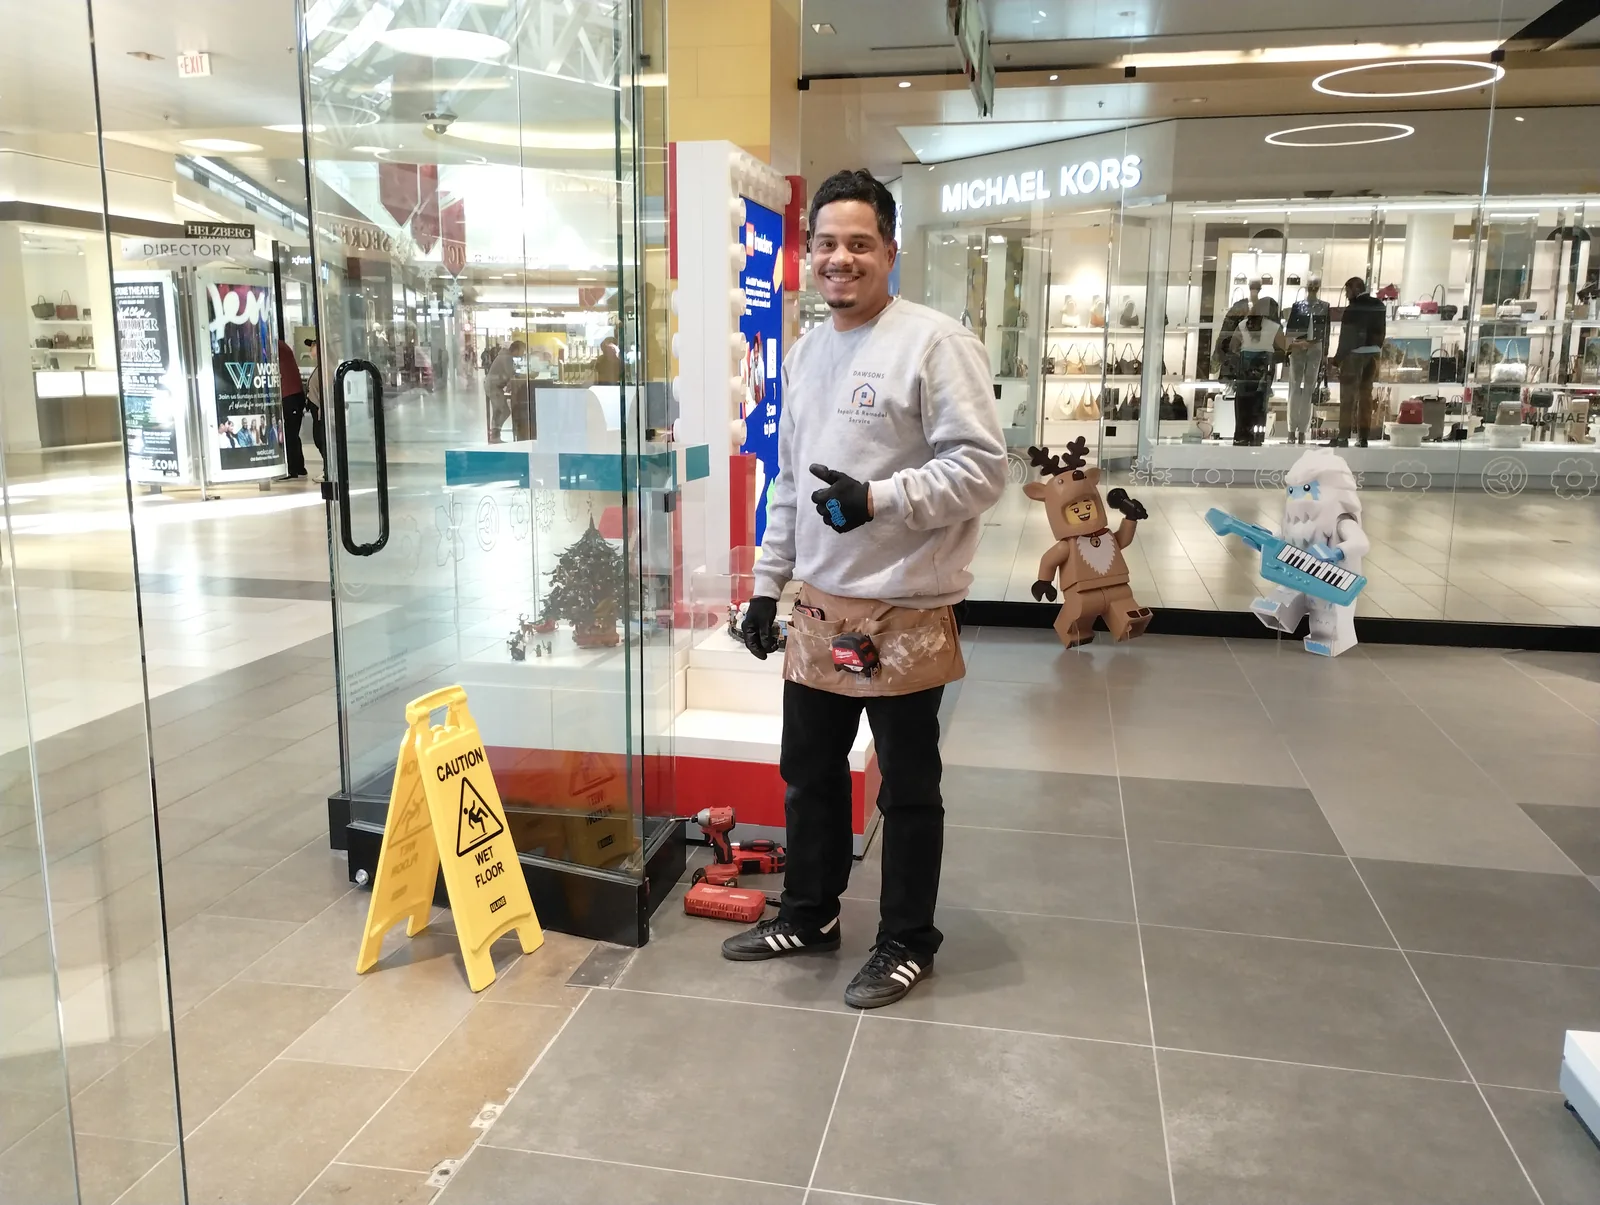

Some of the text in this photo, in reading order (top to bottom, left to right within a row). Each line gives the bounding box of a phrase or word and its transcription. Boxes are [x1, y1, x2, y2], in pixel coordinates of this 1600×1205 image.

[184, 55, 204, 74] EXIT
[942, 154, 1142, 213] MICHAEL KORS
[187, 225, 251, 239] HELZBERG
[143, 243, 231, 256] DIRECTORY
[129, 286, 160, 295] THEATRE
[853, 370, 885, 379] DAWSONS
[254, 375, 267, 389] OF
[849, 416, 871, 424] Service
[862, 410, 888, 418] Remodel
[1525, 412, 1596, 424] MICHAEL
[436, 747, 484, 782] CAUTION
[475, 846, 494, 866] WET
[475, 861, 505, 888] FLOOR
[490, 896, 507, 913] ULINE
